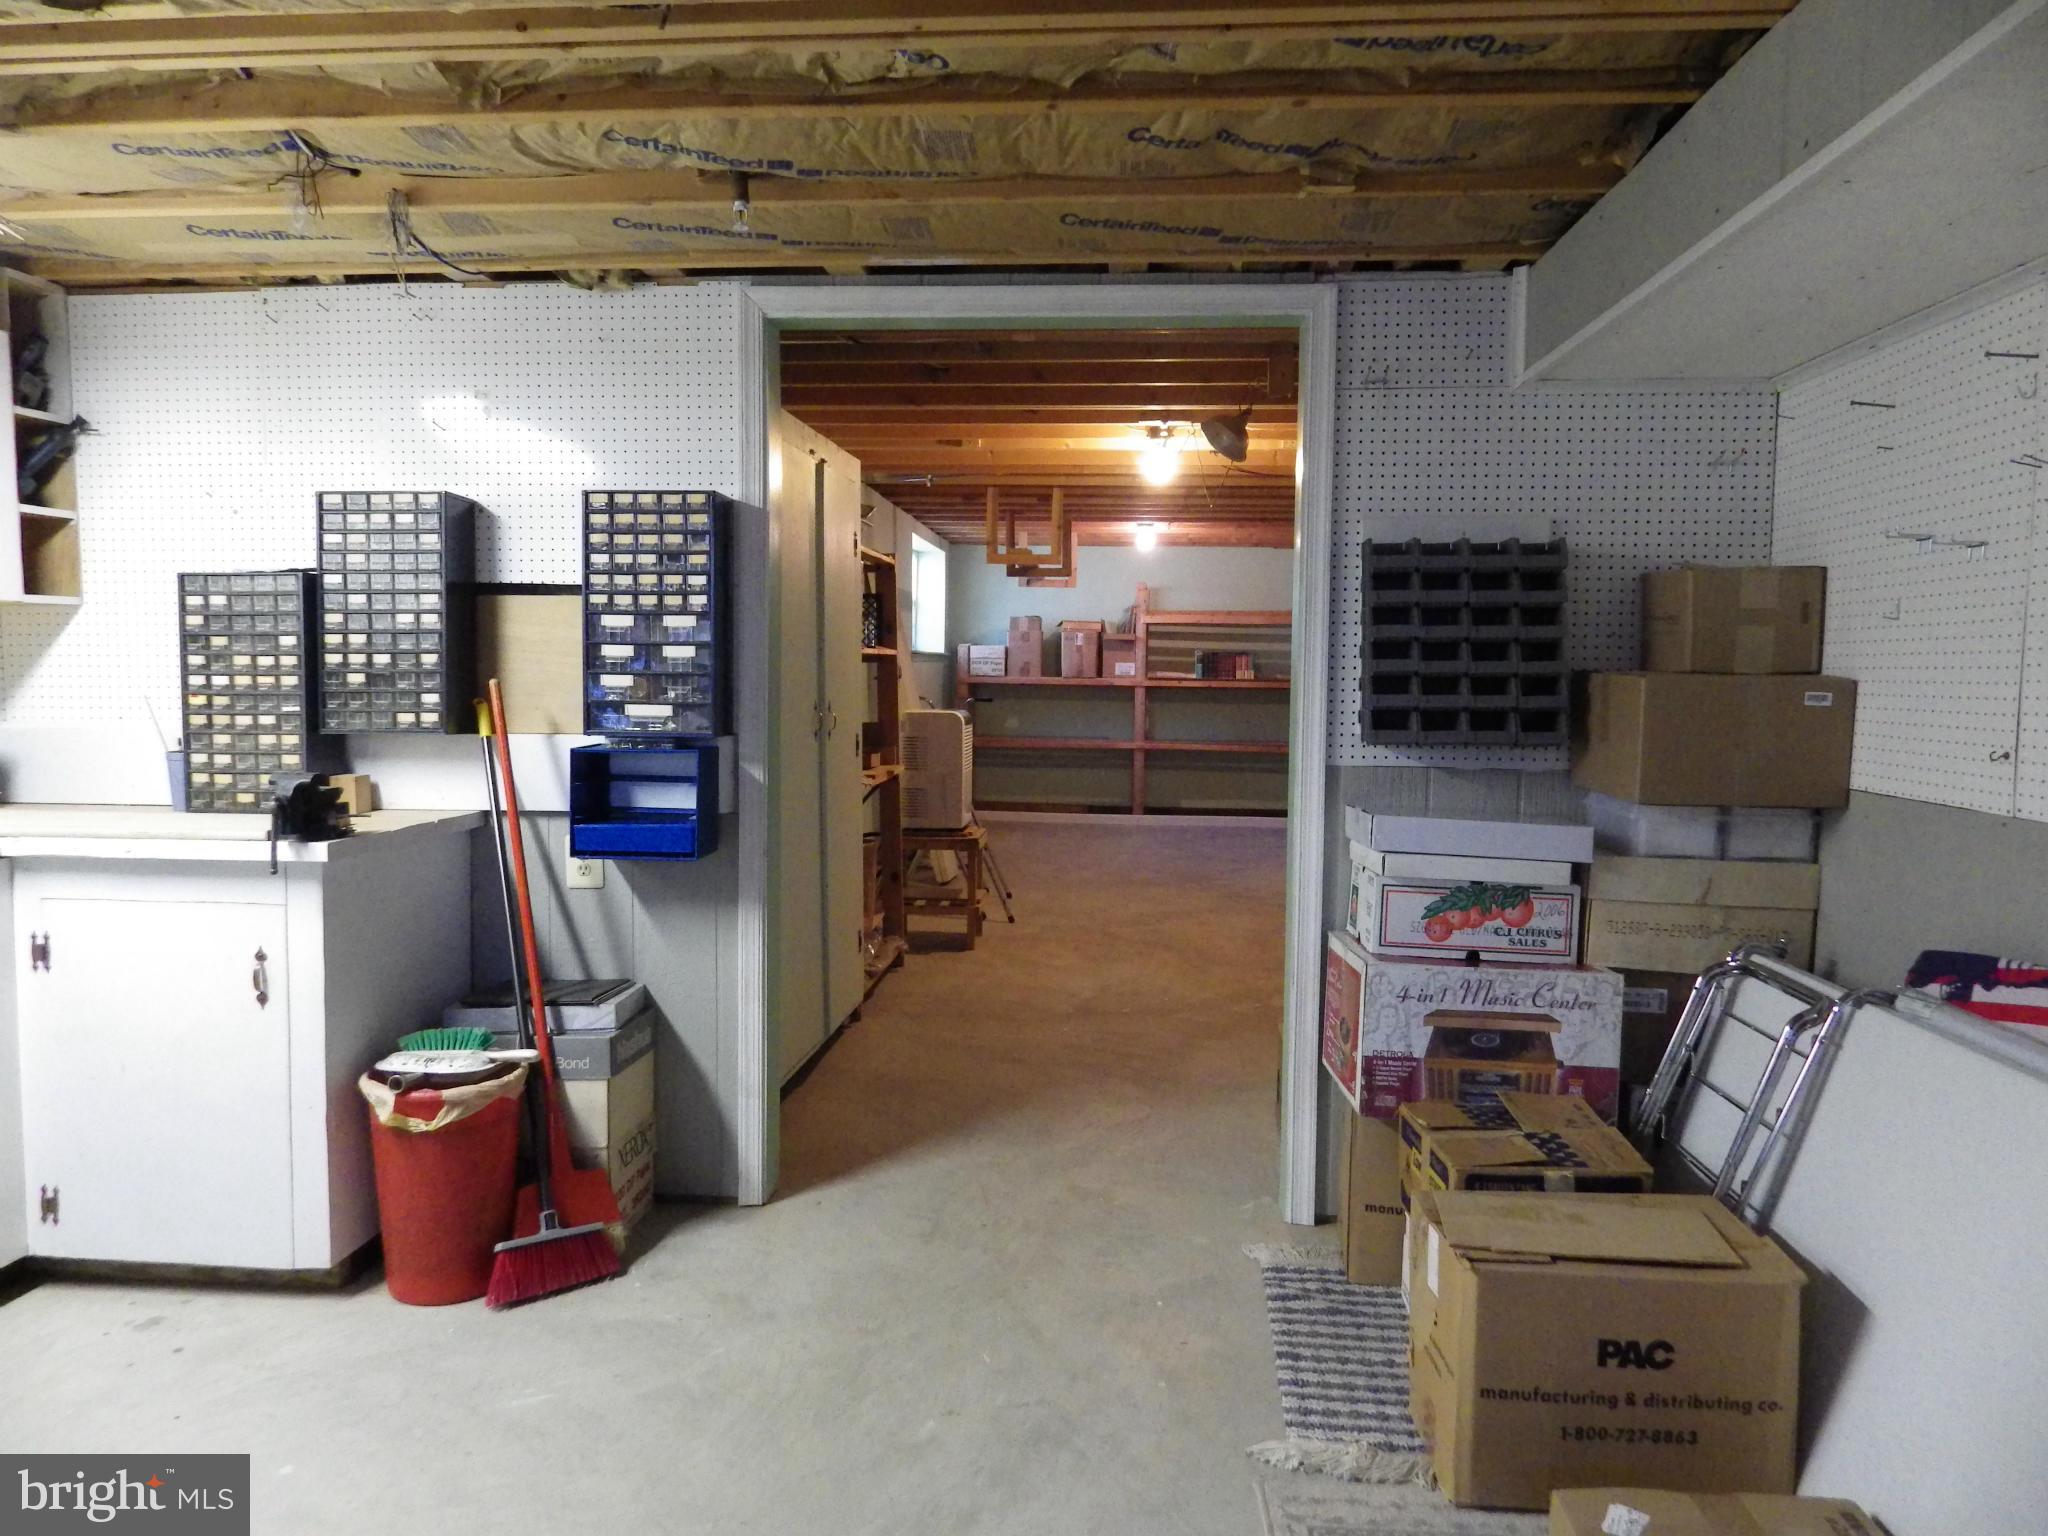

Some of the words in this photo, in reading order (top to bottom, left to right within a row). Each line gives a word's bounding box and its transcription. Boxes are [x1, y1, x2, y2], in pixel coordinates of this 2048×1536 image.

[601, 130, 764, 170] CertainTeed
[612, 217, 753, 239] CertainTeed
[1059, 213, 1198, 235] CertainTeed
[1508, 937, 1548, 948] SALES
[1516, 927, 1562, 940] CITRUS
[1460, 978, 1525, 1008] Music
[1532, 980, 1598, 1011] Center
[556, 1057, 590, 1069] Bond
[1597, 1338, 1676, 1371] PAC
[1480, 1386, 1619, 1410] manufacturing
[1626, 1391, 1637, 1406] &
[1643, 1391, 1753, 1416] distributing
[1758, 1400, 1783, 1413] co.
[1561, 1426, 1699, 1446] 1-800-727-8863
